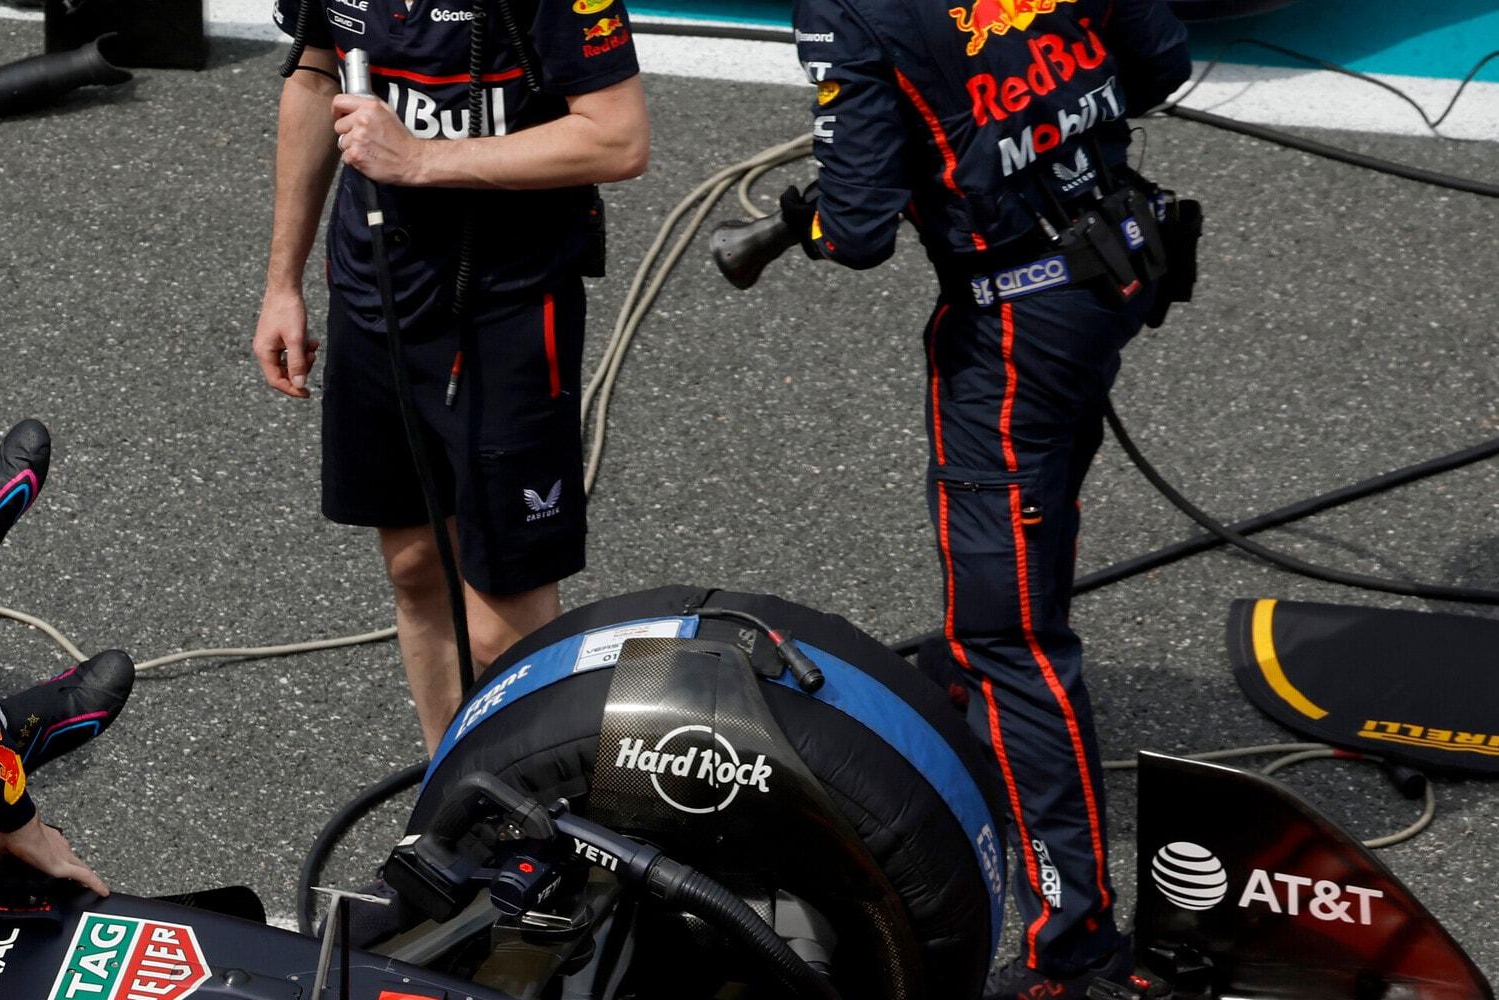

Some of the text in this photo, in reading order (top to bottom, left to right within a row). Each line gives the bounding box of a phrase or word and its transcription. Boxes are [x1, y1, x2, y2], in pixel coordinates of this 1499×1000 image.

[966, 16, 1108, 127] Red Bu
[999, 95, 1100, 176] Mobil
[615, 738, 774, 794] Hard Rock
[573, 838, 619, 872] YETI
[1238, 868, 1383, 925] AT&T
[65, 921, 121, 999] TAG
